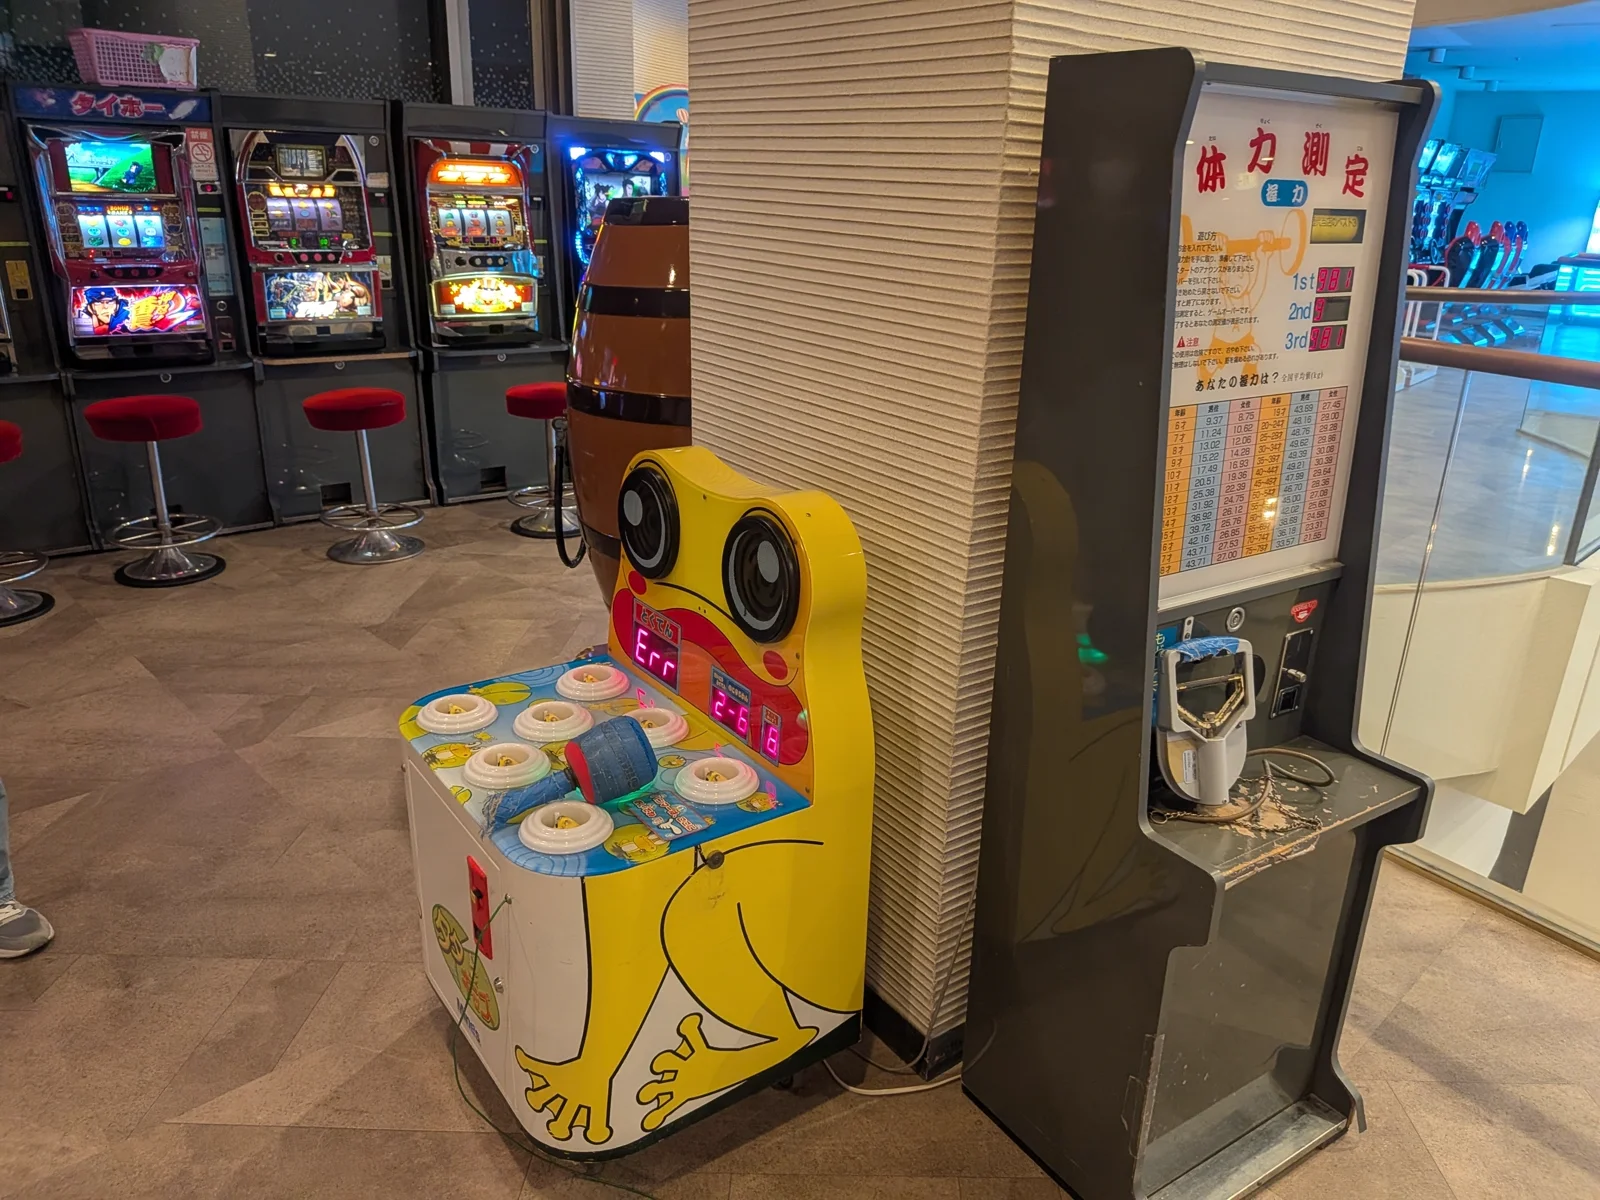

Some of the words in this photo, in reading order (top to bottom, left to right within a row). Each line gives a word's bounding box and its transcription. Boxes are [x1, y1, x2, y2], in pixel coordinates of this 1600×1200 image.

[71, 91, 165, 118] タイホー
[1196, 127, 1369, 198] 体力測定
[1266, 184, 1304, 203] 握力
[1197, 232, 1217, 241] 遊び方
[1177, 277, 1223, 285] バーを引いて下さい。
[1293, 273, 1315, 290] 1st
[1288, 302, 1312, 320] 2nd
[1186, 338, 1199, 347] 注意
[1285, 331, 1308, 349] 3rd
[1206, 416, 1223, 425] 9.37
[1238, 412, 1254, 421] 8.75
[1174, 434, 1186, 442] 7才
[1201, 429, 1221, 438] 11.24
[1233, 424, 1253, 433] 10.62
[1200, 441, 1220, 450] 13.02
[1232, 436, 1251, 445] 12.06
[1172, 458, 1182, 467] 9才
[1198, 453, 1219, 463] 15.22
[1231, 448, 1250, 457] 14.28
[1167, 471, 1181, 479] 10才
[1197, 465, 1217, 474] 17.49
[1229, 459, 1248, 469] 16.93
[1195, 477, 1215, 487] 20.51
[1228, 471, 1247, 481] 19.36
[1225, 483, 1245, 493] 22.39
[1192, 500, 1213, 510] 31.92
[1224, 495, 1244, 504] 24.75
[1190, 523, 1210, 534] 39.72
[1221, 517, 1241, 527] 25.76
[1187, 546, 1207, 556] 43.71
[1218, 540, 1238, 550] 27.53
[1188, 535, 1209, 545] 42.16
[1186, 558, 1206, 568] 43.71
[1217, 551, 1237, 561] 27.00
[640, 608, 673, 639] とくてん
[635, 628, 675, 677] Err
